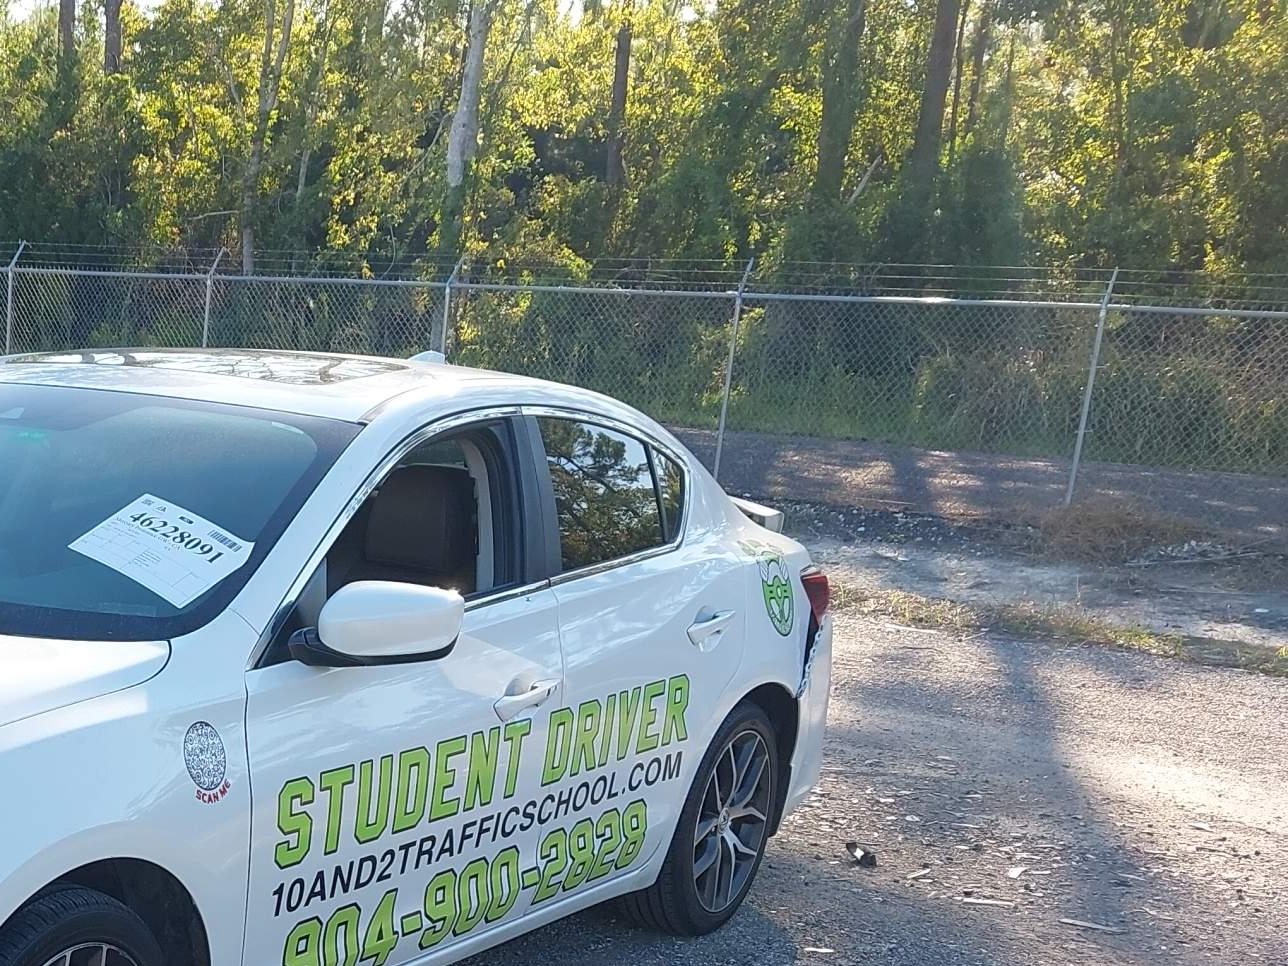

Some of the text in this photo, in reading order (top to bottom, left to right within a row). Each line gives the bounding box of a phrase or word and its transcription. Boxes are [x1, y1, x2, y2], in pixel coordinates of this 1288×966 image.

[130, 512, 224, 563] 46228091
[196, 779, 231, 804] SCAN ME
[274, 674, 690, 870] STUDENT DRIVER
[272, 750, 683, 916] 10AND2TRAFFICSCHOOL.COM
